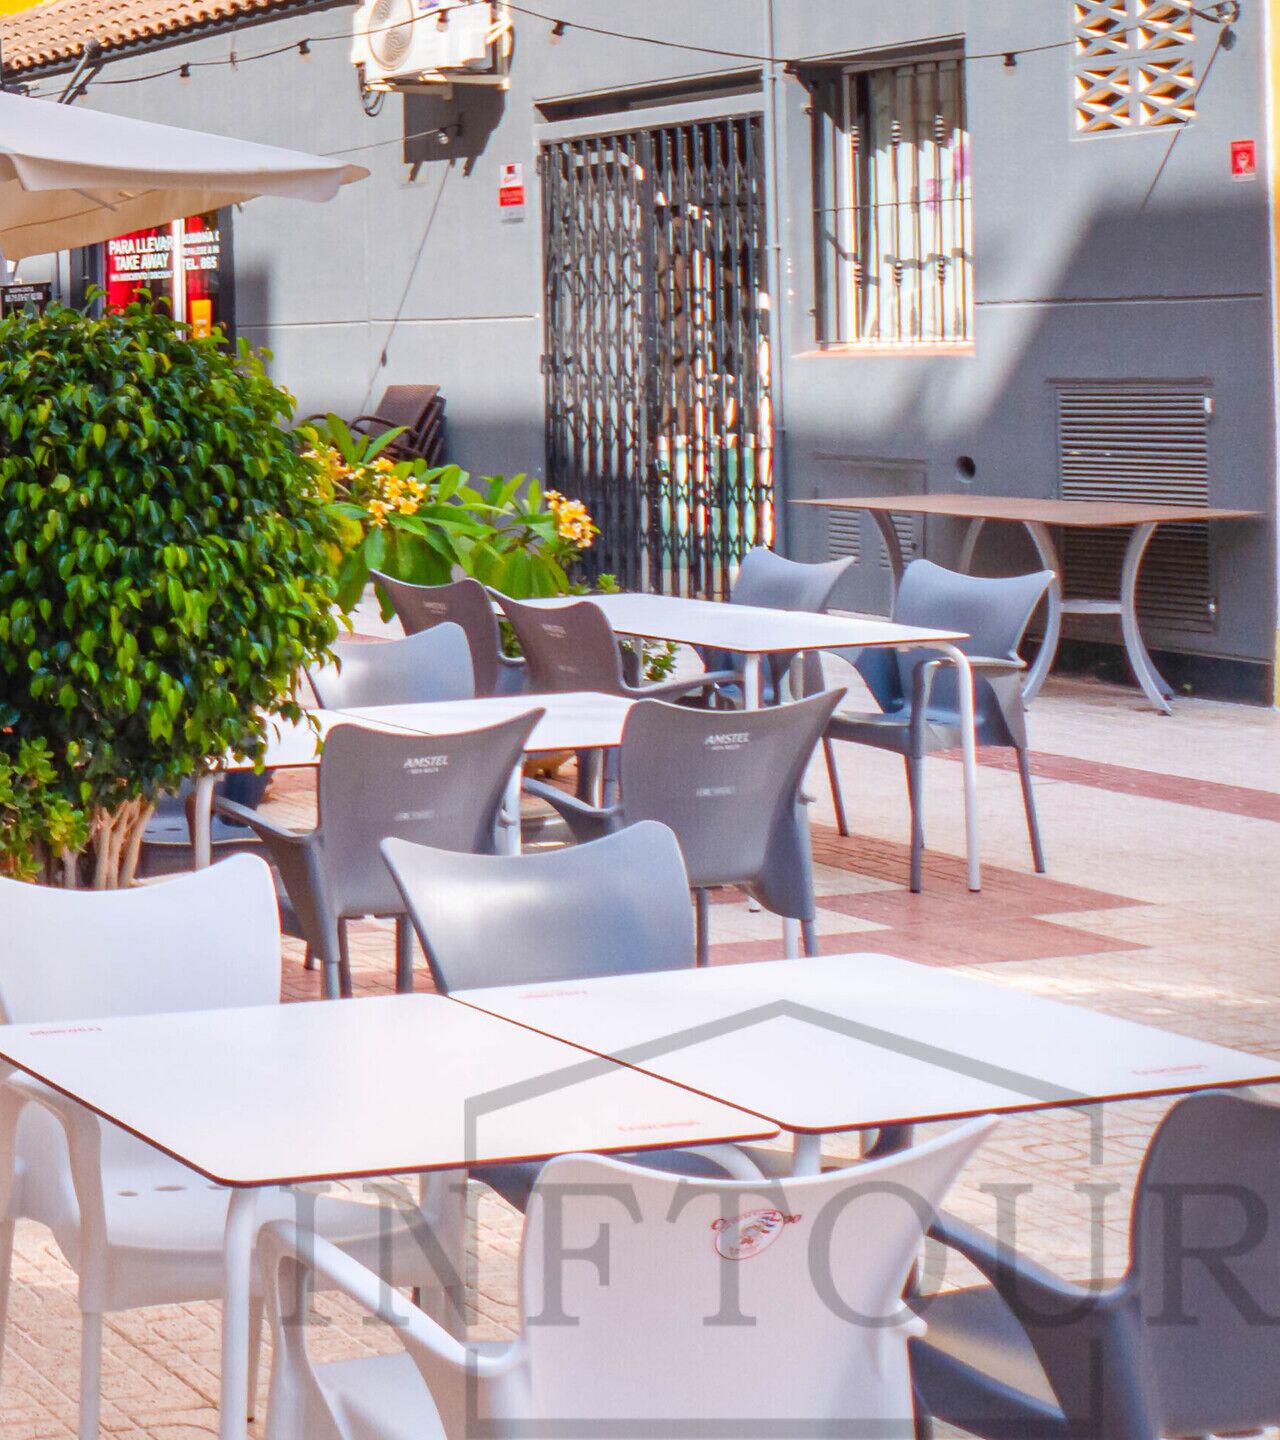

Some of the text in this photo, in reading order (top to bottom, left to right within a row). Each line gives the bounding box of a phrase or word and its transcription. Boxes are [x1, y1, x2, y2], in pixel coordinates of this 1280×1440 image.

[108, 239, 135, 256] PARA
[114, 252, 170, 272] TAKE AWAY
[703, 731, 750, 745] AMSTEL
[403, 754, 449, 769] AMSTEL
